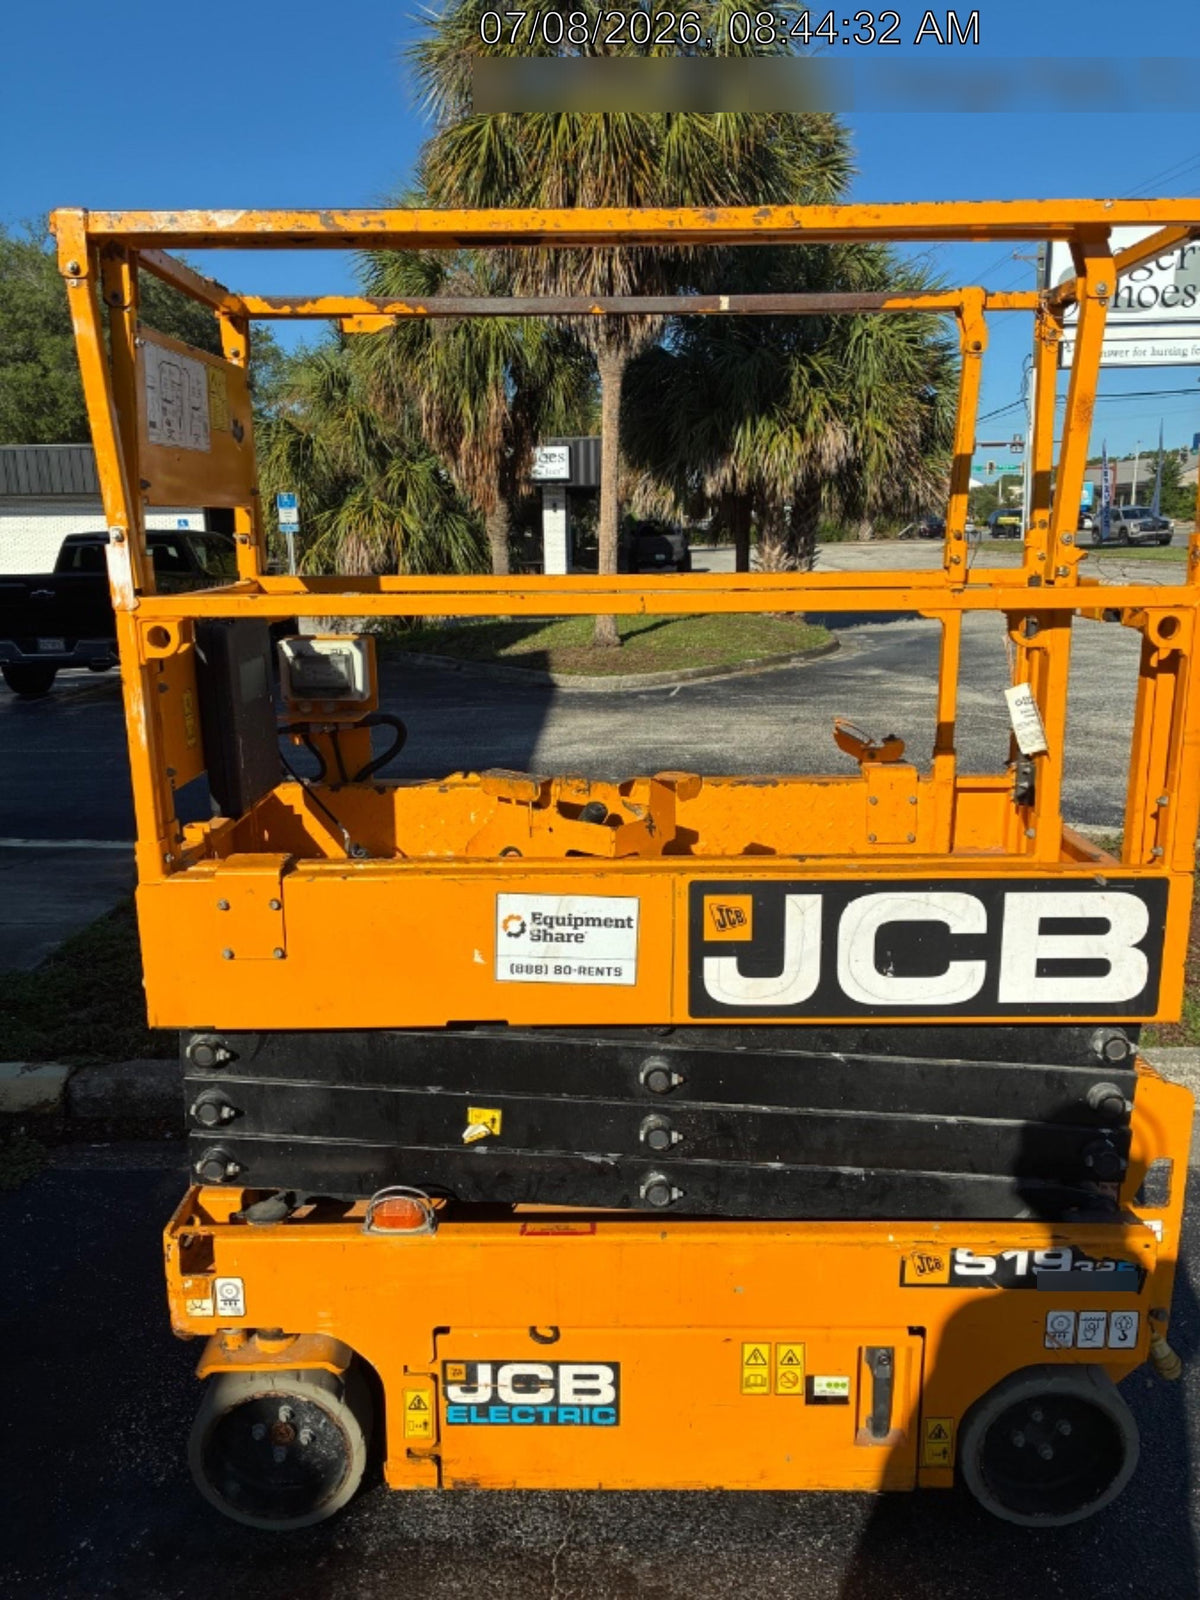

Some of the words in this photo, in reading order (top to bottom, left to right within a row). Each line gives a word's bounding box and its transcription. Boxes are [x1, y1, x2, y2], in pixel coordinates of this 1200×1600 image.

[1112, 278, 1197, 309] hoes
[530, 912, 634, 930] Equipment
[714, 905, 745, 930] JCB
[529, 929, 586, 943] Share
[703, 892, 1149, 1005] JCB
[509, 963, 549, 975] (888)
[553, 964, 623, 977] 80-RENTS
[915, 1253, 943, 1274] JCB
[447, 1363, 616, 1405] JCB
[447, 1405, 616, 1424] ELECTRIC
